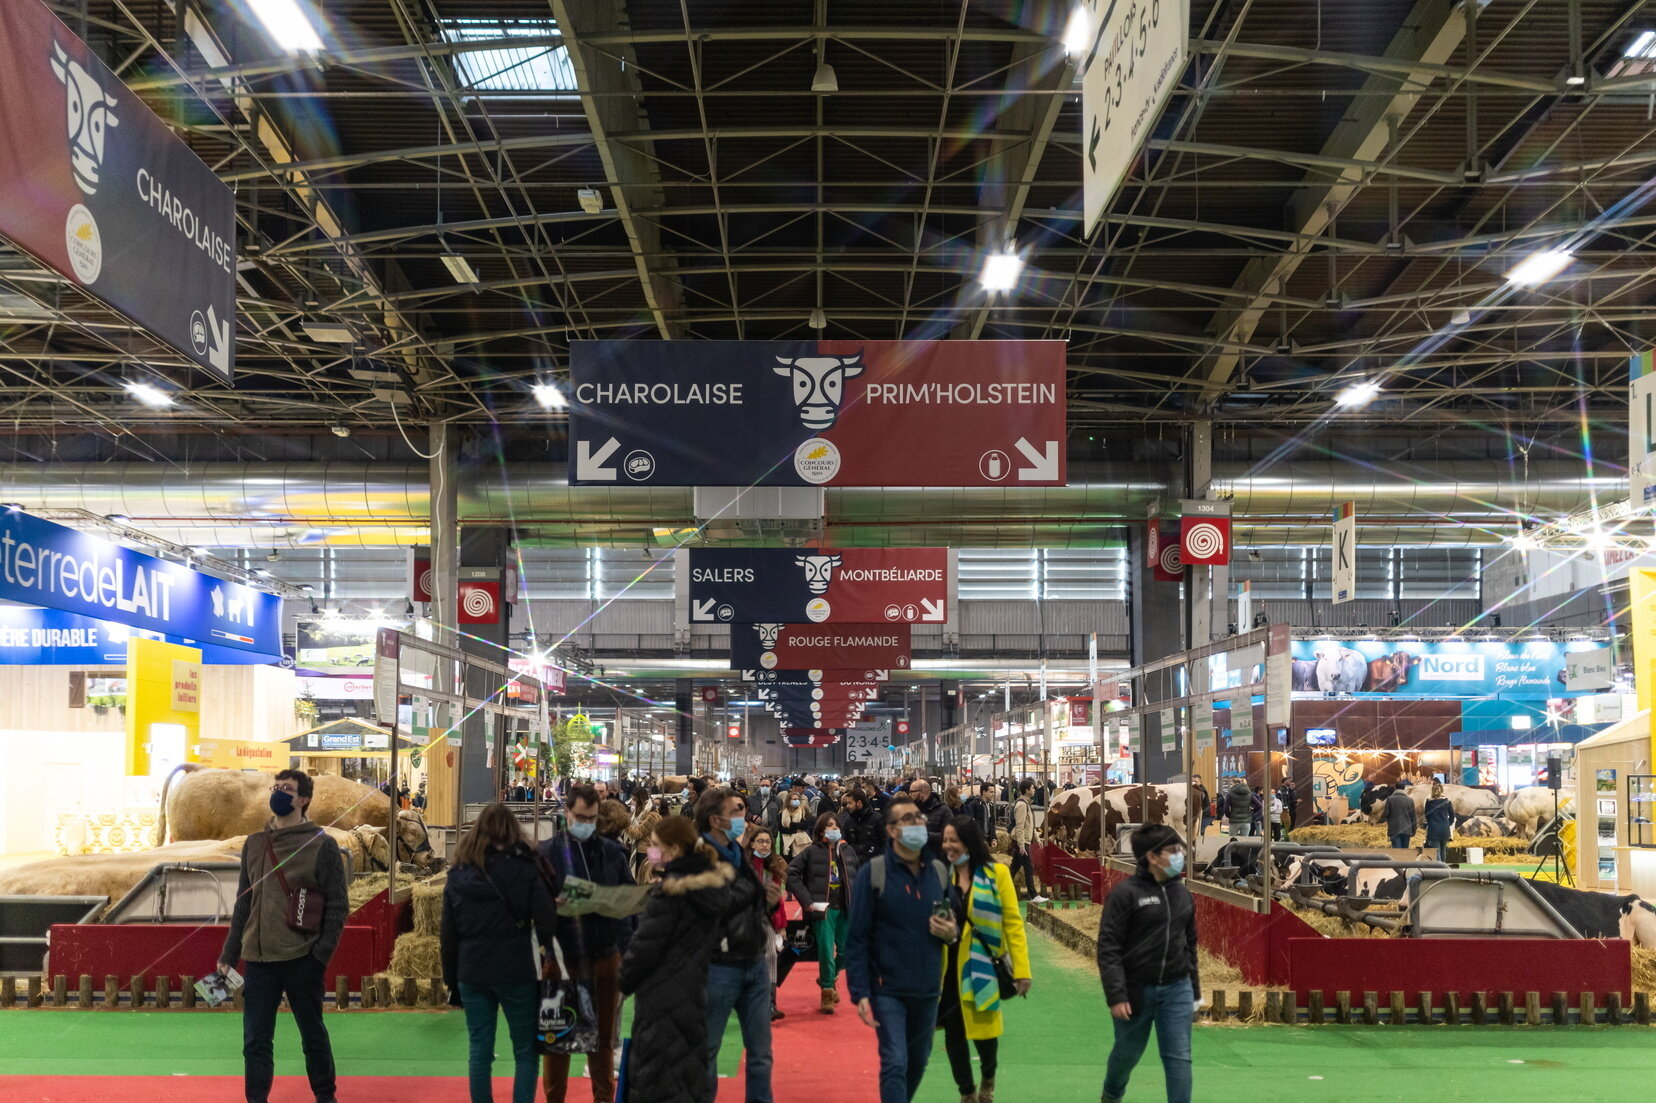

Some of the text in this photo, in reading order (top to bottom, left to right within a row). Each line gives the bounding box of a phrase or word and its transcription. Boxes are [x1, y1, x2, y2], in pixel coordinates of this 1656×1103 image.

[137, 168, 231, 274] CHAROLAISE
[576, 382, 743, 404] CHAROLAISE
[866, 382, 1056, 404] PRIM'HOLSTEIN
[1339, 529, 1349, 571] K
[692, 568, 755, 582] SALERS
[840, 566, 943, 581] MONTBÉLIARDE
[31, 628, 98, 647] DURABLE
[789, 636, 898, 647] ROUGE FLAMANDE
[1424, 657, 1479, 673] Nord
[324, 735, 360, 743] Grand Est
[848, 750, 857, 762] 6
[296, 888, 307, 926] LACOSTE
